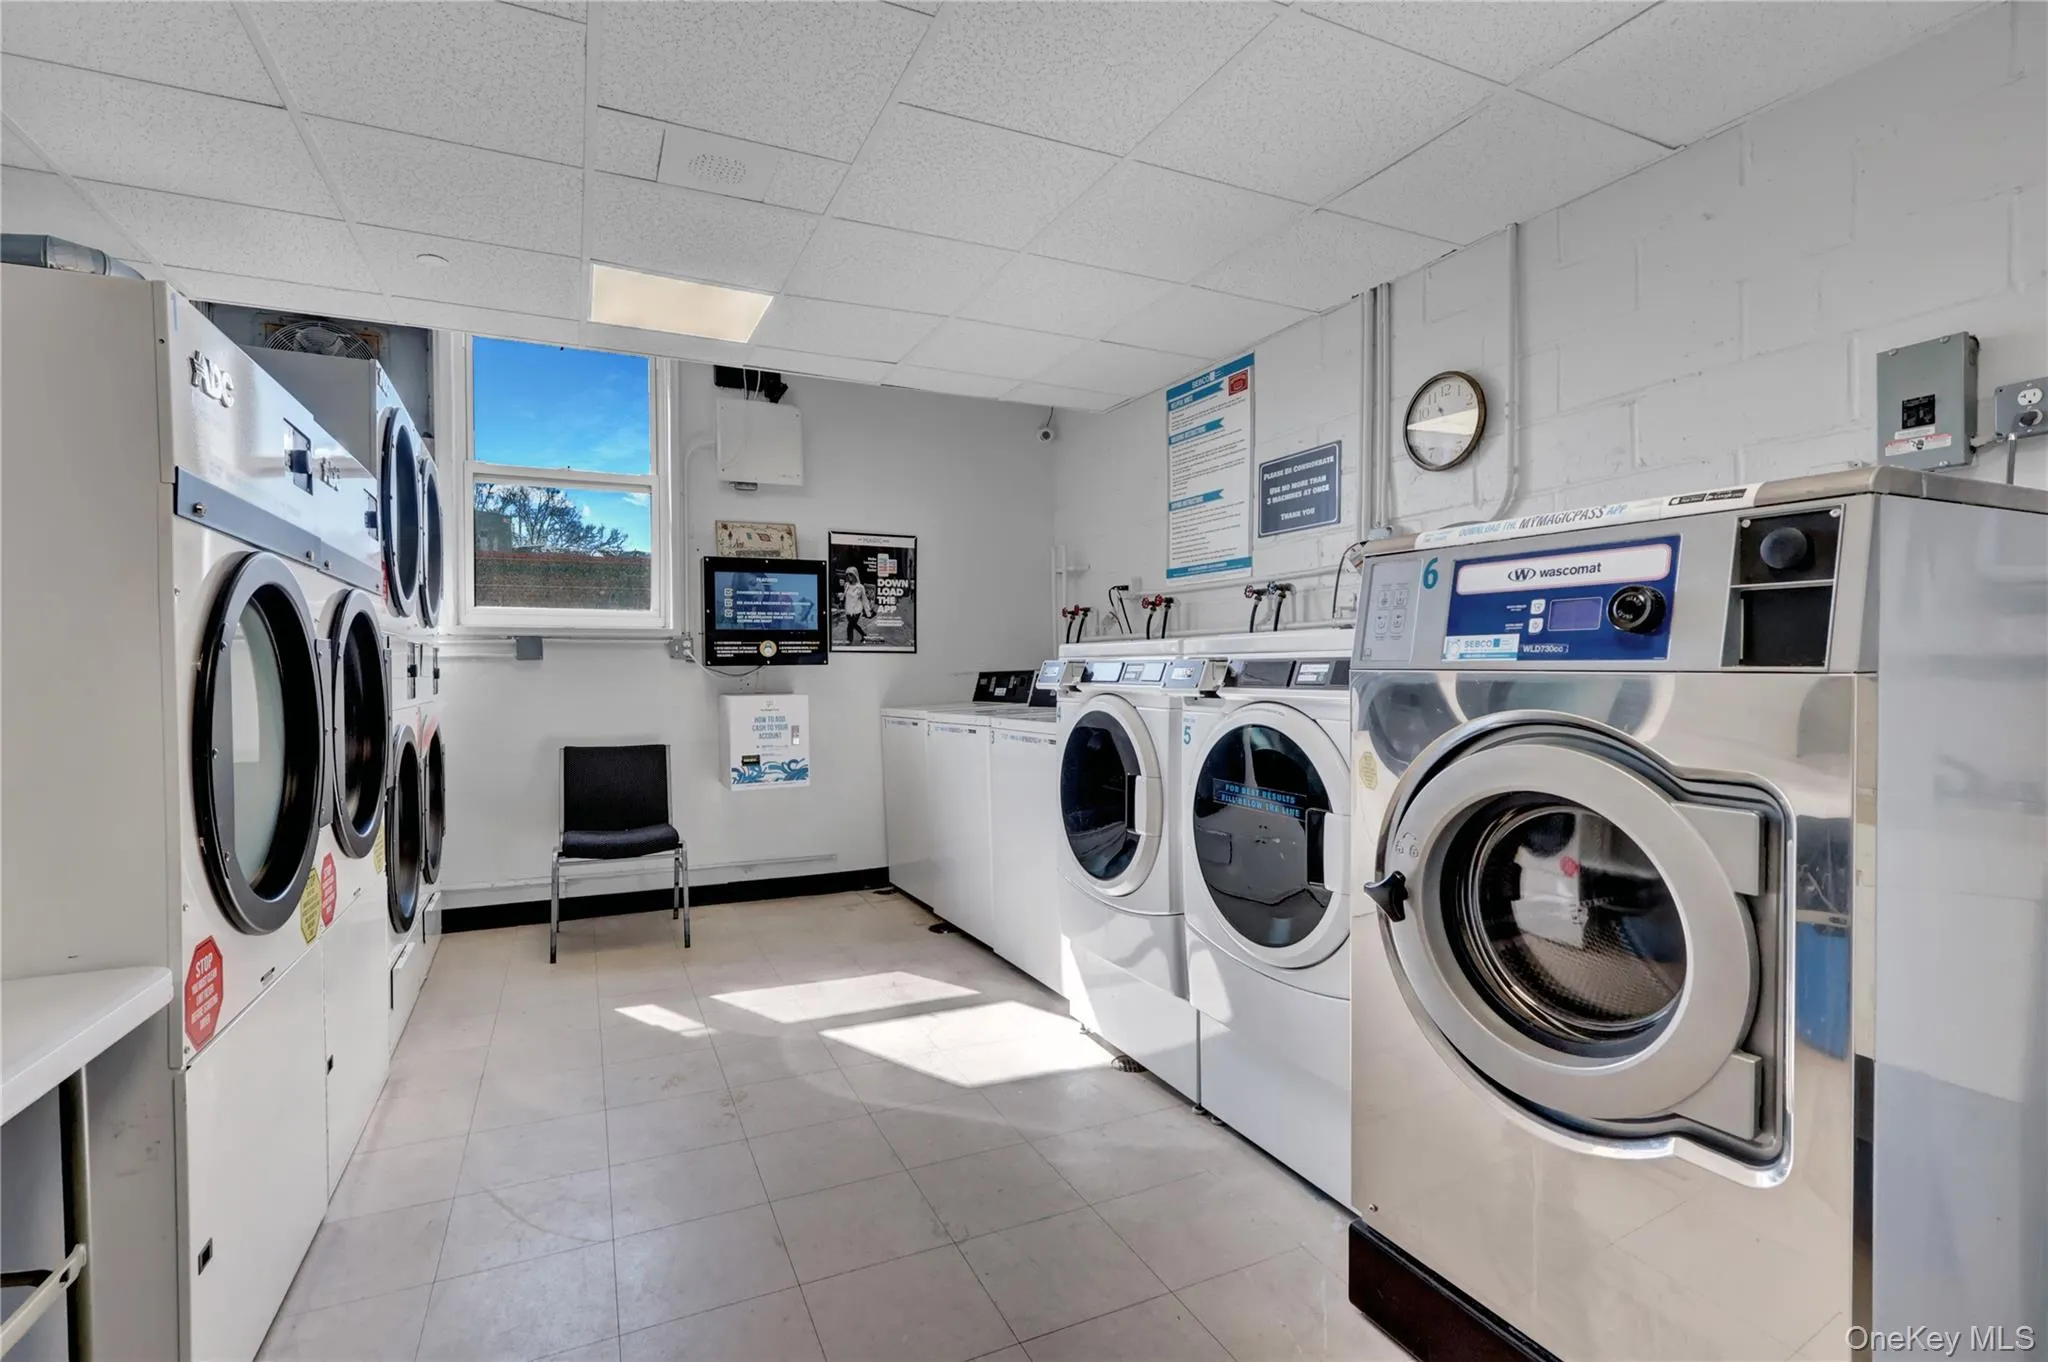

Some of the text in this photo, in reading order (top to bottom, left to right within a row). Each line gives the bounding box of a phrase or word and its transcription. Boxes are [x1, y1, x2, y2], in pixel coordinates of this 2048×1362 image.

[1263, 455, 1334, 480] PLEASE BE CONSIDERATE
[1269, 475, 1327, 495] USE NO MORE THAN
[1272, 490, 1302, 503] MACHINES
[1303, 488, 1312, 496] AT
[1312, 484, 1330, 494] ONCE
[1280, 507, 1315, 520] THANK YOU
[1459, 523, 1499, 537] DOWNLOAD
[1606, 504, 1628, 516] APP
[1423, 557, 1439, 590] 6
[1540, 562, 1602, 578] wascomat
[877, 579, 909, 588] DOWN
[877, 587, 904, 596] LOAD
[877, 596, 896, 605] THE
[877, 605, 897, 613] APP
[1464, 639, 1492, 648] SEBCO
[775, 723, 789, 731] YOUR
[1183, 725, 1192, 745] 5
[759, 732, 782, 740] ACCOUNT
[1225, 784, 1296, 804] FOR BEST RESULTS
[1221, 793, 1300, 817] FILL BELOW THE LINE
[196, 952, 213, 979] STOP
